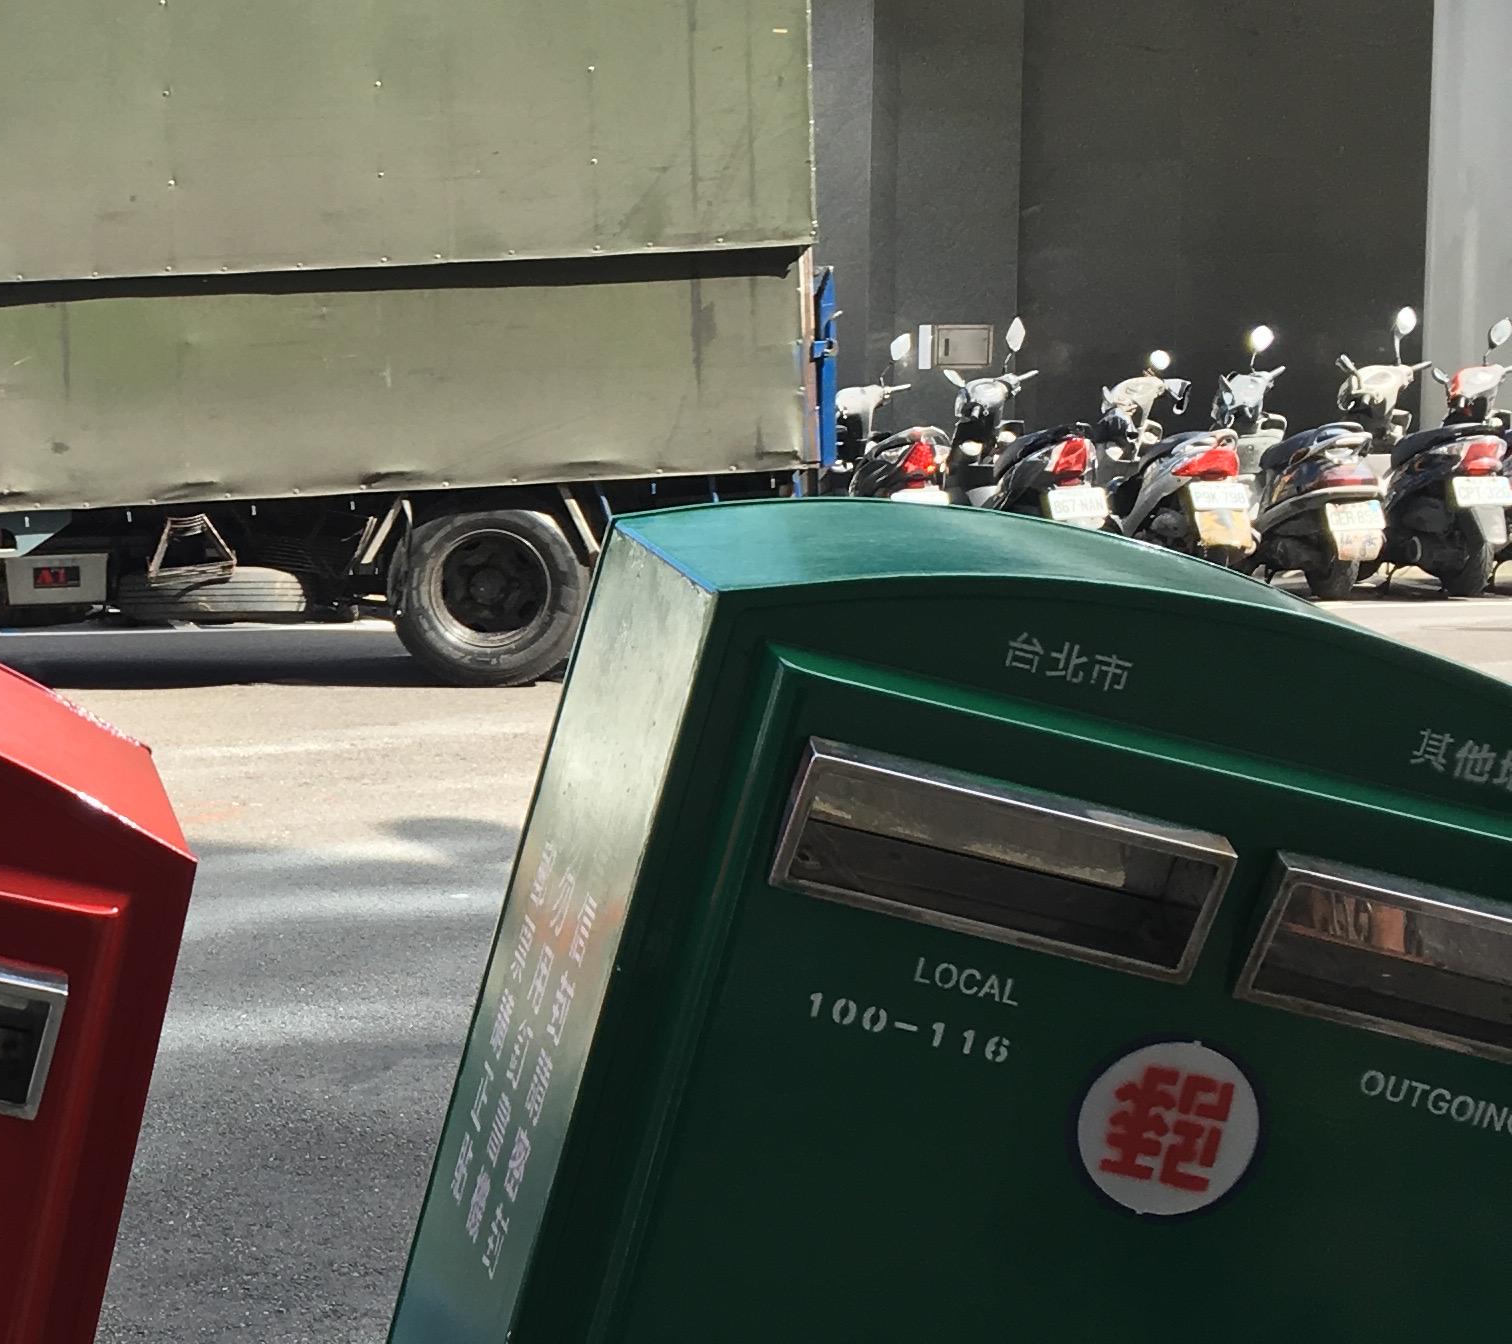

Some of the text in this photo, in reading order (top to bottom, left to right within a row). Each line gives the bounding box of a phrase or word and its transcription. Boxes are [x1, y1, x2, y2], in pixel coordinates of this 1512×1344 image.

[1005, 632, 1134, 692] 台北市
[914, 956, 1019, 1007] LOCAL
[809, 991, 1012, 1064] 100-116
[1098, 1063, 1235, 1193] 郵
[1360, 1068, 1512, 1136] OUTGOIN
